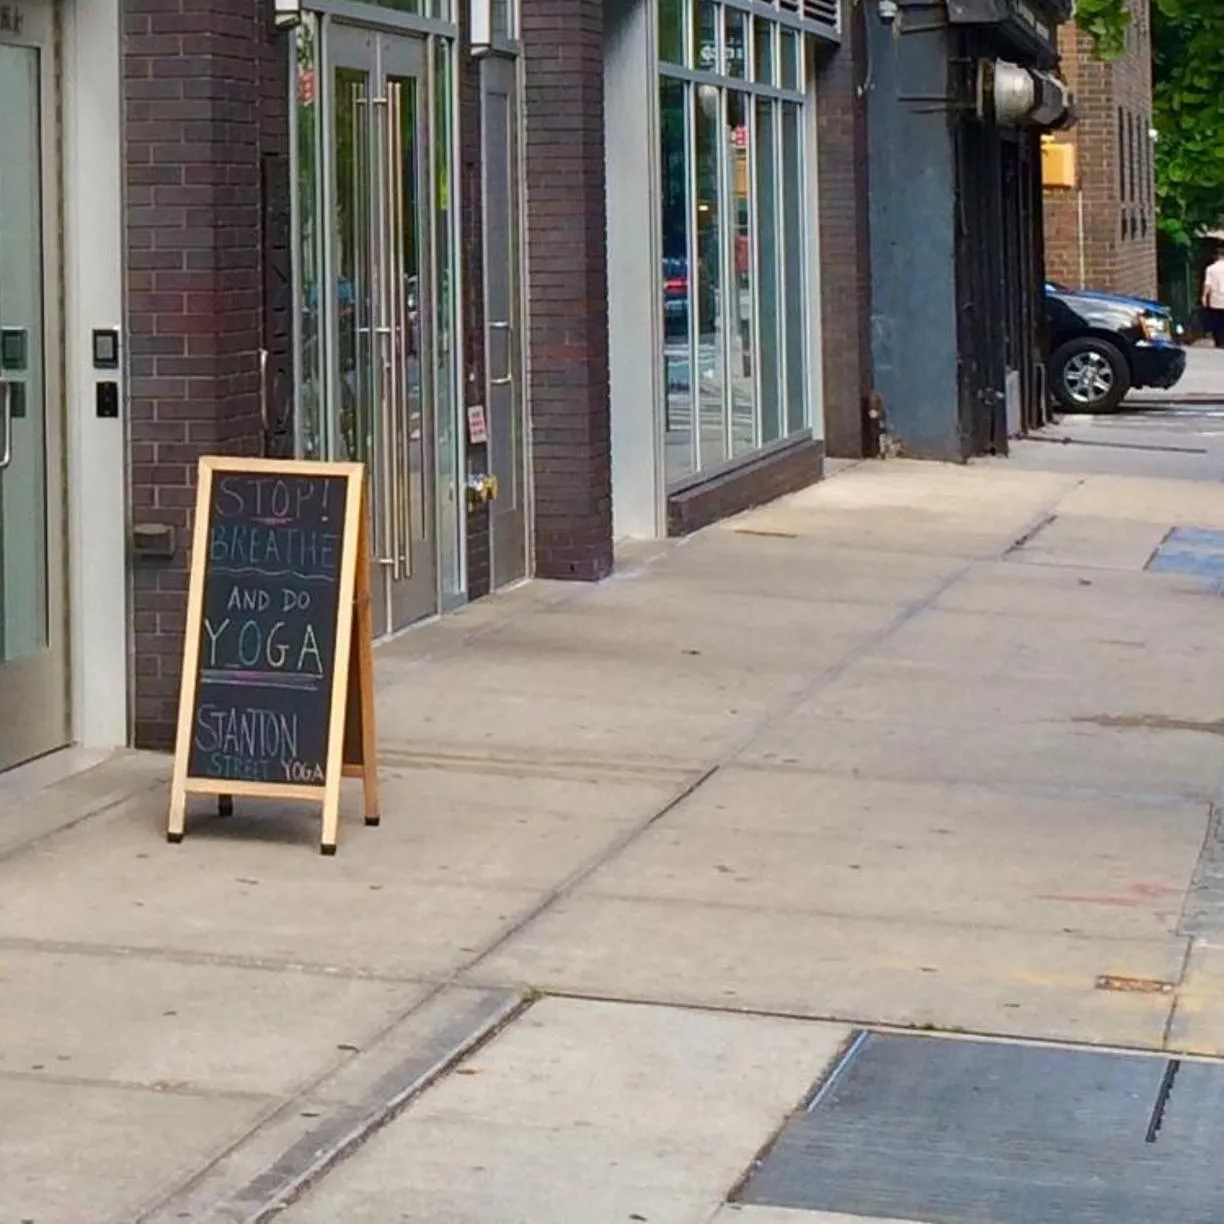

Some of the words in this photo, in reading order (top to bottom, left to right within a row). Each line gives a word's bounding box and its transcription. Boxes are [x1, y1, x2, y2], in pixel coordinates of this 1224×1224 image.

[215, 478, 330, 522] STOP!
[211, 525, 339, 569] BREATHE
[227, 585, 270, 613] AND
[282, 588, 311, 613] DO
[204, 618, 325, 676] YOGA
[195, 704, 297, 758] STANTON
[281, 759, 324, 781] YOGA
